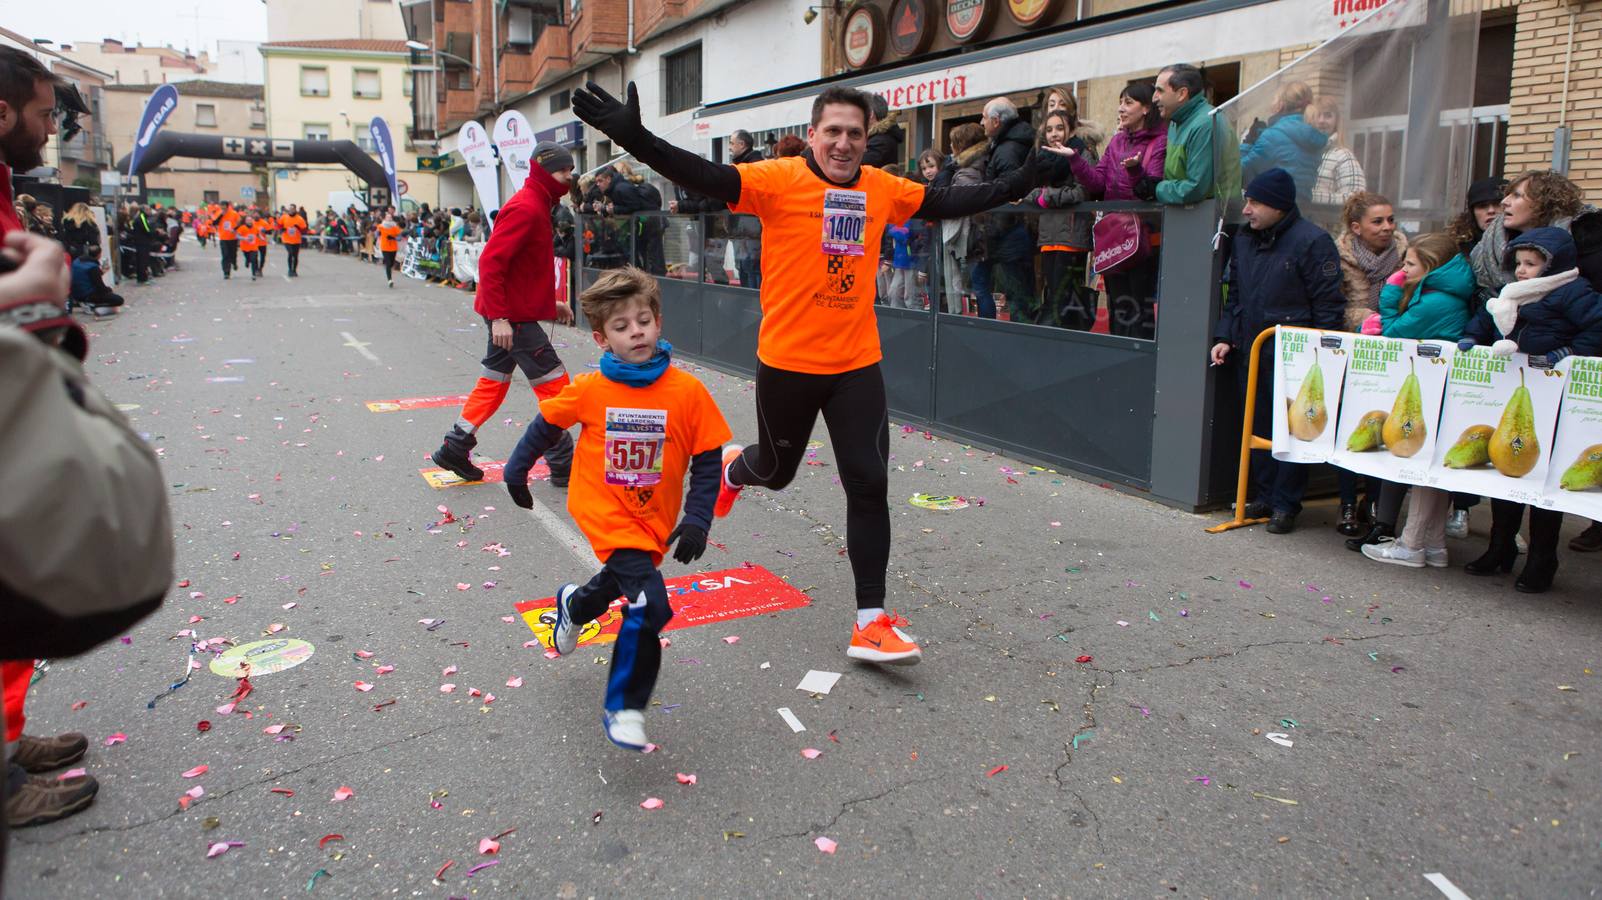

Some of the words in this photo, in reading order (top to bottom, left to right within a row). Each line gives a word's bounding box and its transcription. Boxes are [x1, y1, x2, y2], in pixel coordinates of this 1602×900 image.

[829, 215, 861, 241] 1400
[1354, 338, 1384, 351] PERAS
[1386, 341, 1404, 352] DEL
[1353, 349, 1380, 362] VALLE
[1382, 351, 1398, 362] DEL
[1351, 359, 1387, 373] IREGUA
[1453, 357, 1483, 371] VALLE
[1486, 360, 1506, 373] DEL
[1451, 368, 1491, 384] IREGUA
[1571, 370, 1602, 385] VALL
[612, 439, 658, 470] 557
